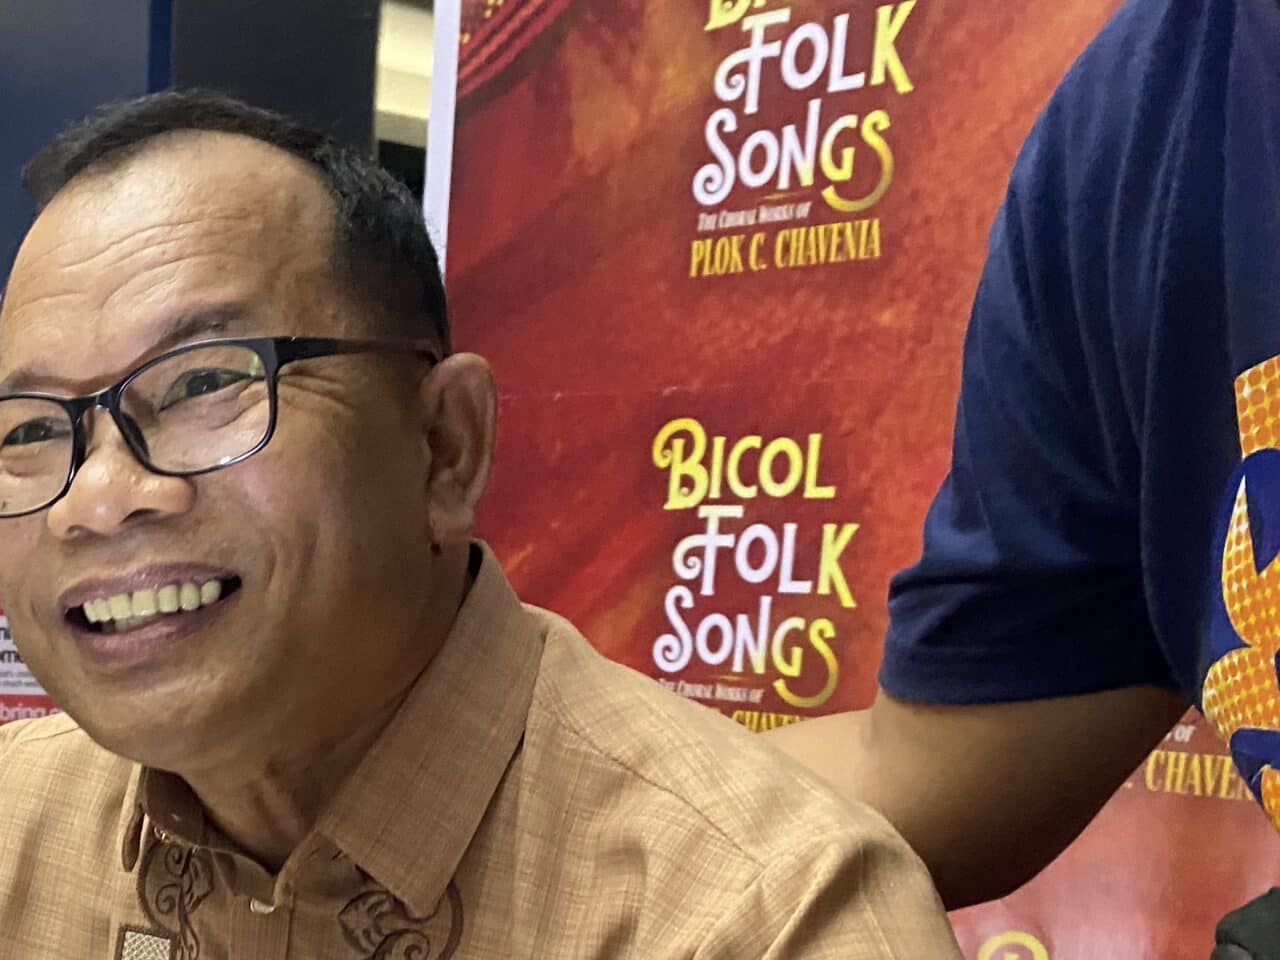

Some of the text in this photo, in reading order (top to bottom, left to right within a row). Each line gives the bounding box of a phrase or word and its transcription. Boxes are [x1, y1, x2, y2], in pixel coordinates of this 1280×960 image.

[714, 0, 917, 115] FOLK
[692, 98, 895, 213] SONGS
[689, 217, 881, 278] PLOK C. CHAVENIA
[652, 417, 837, 510] BICOL
[672, 504, 860, 609] FOLK
[652, 585, 839, 708] SONGS
